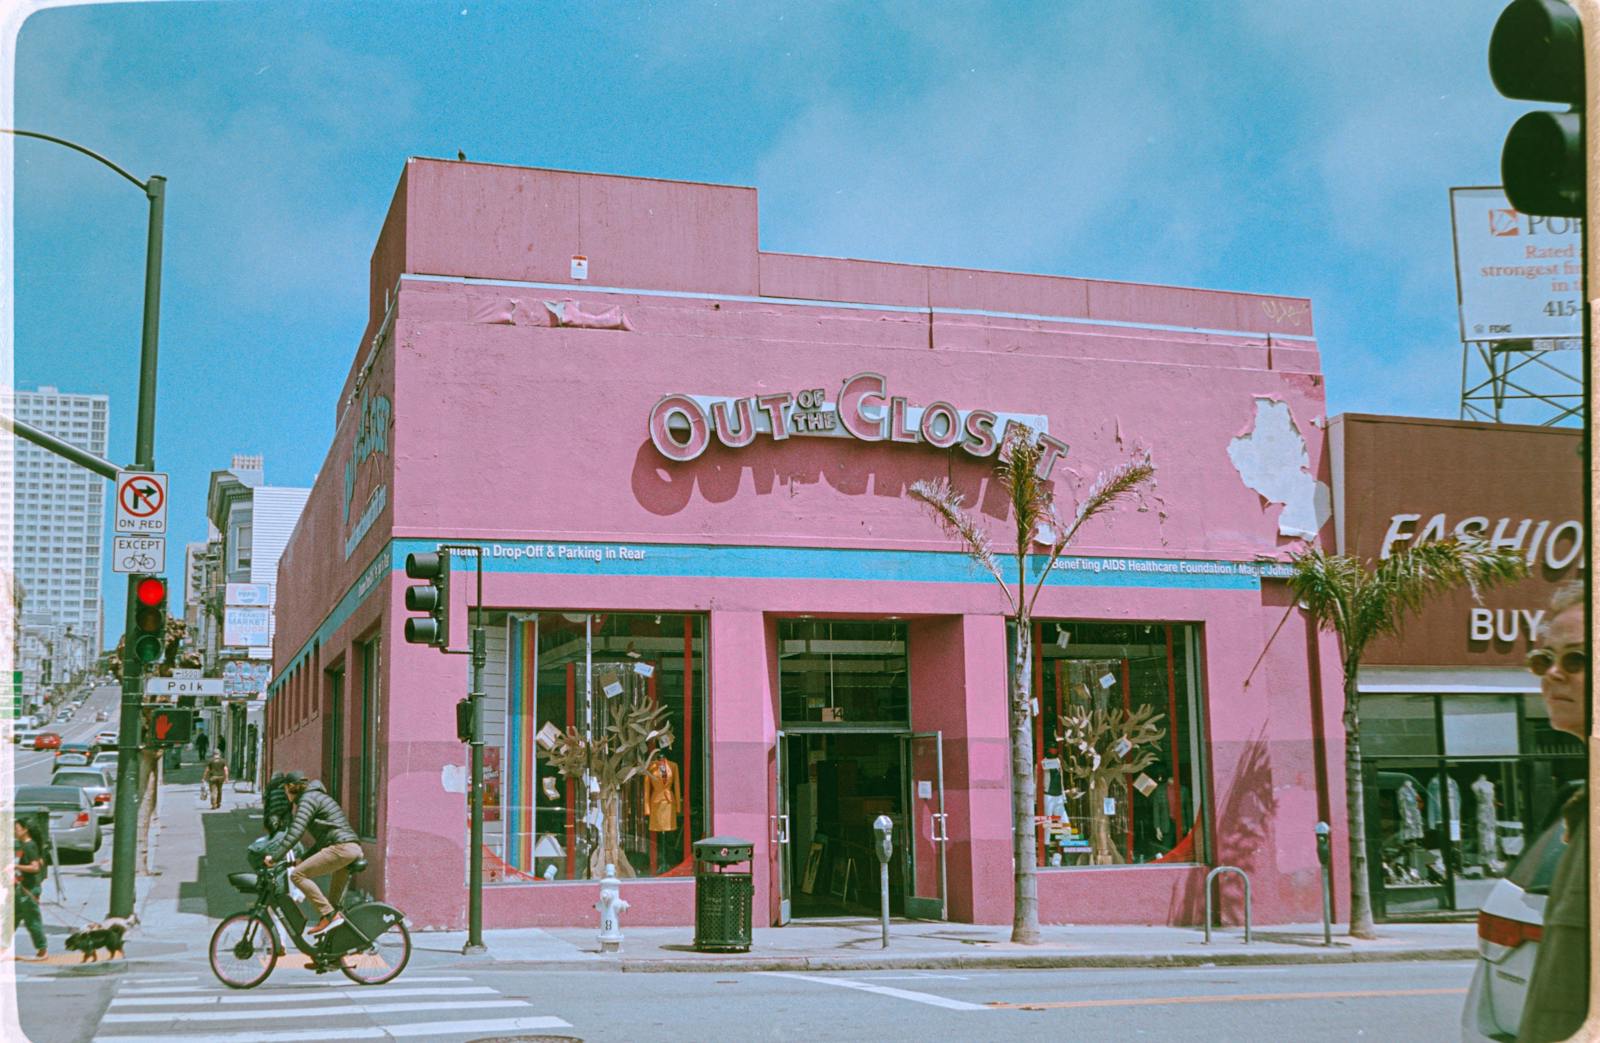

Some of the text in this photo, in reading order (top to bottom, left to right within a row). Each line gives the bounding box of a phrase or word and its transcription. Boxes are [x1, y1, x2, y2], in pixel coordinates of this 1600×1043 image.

[1525, 244, 1574, 259] Rated
[1481, 264, 1558, 280] strongest
[797, 388, 826, 409] OF
[649, 392, 793, 462] OUT
[793, 410, 837, 432] THE
[119, 519, 163, 529] ON RED
[118, 540, 161, 550] EXCEPT
[1380, 513, 1585, 570] FASHIO
[493, 544, 545, 560] Drop-Off
[546, 545, 555, 557] &
[558, 546, 602, 562] Parking
[605, 546, 616, 559] in
[619, 547, 646, 560] Rear
[1102, 560, 1126, 571] AIDS
[1128, 560, 1178, 573] Healthcare
[1180, 562, 1231, 574] Foundation
[1470, 607, 1545, 642] BUY
[168, 681, 203, 691] Polk
[605, 919, 612, 931] 8
